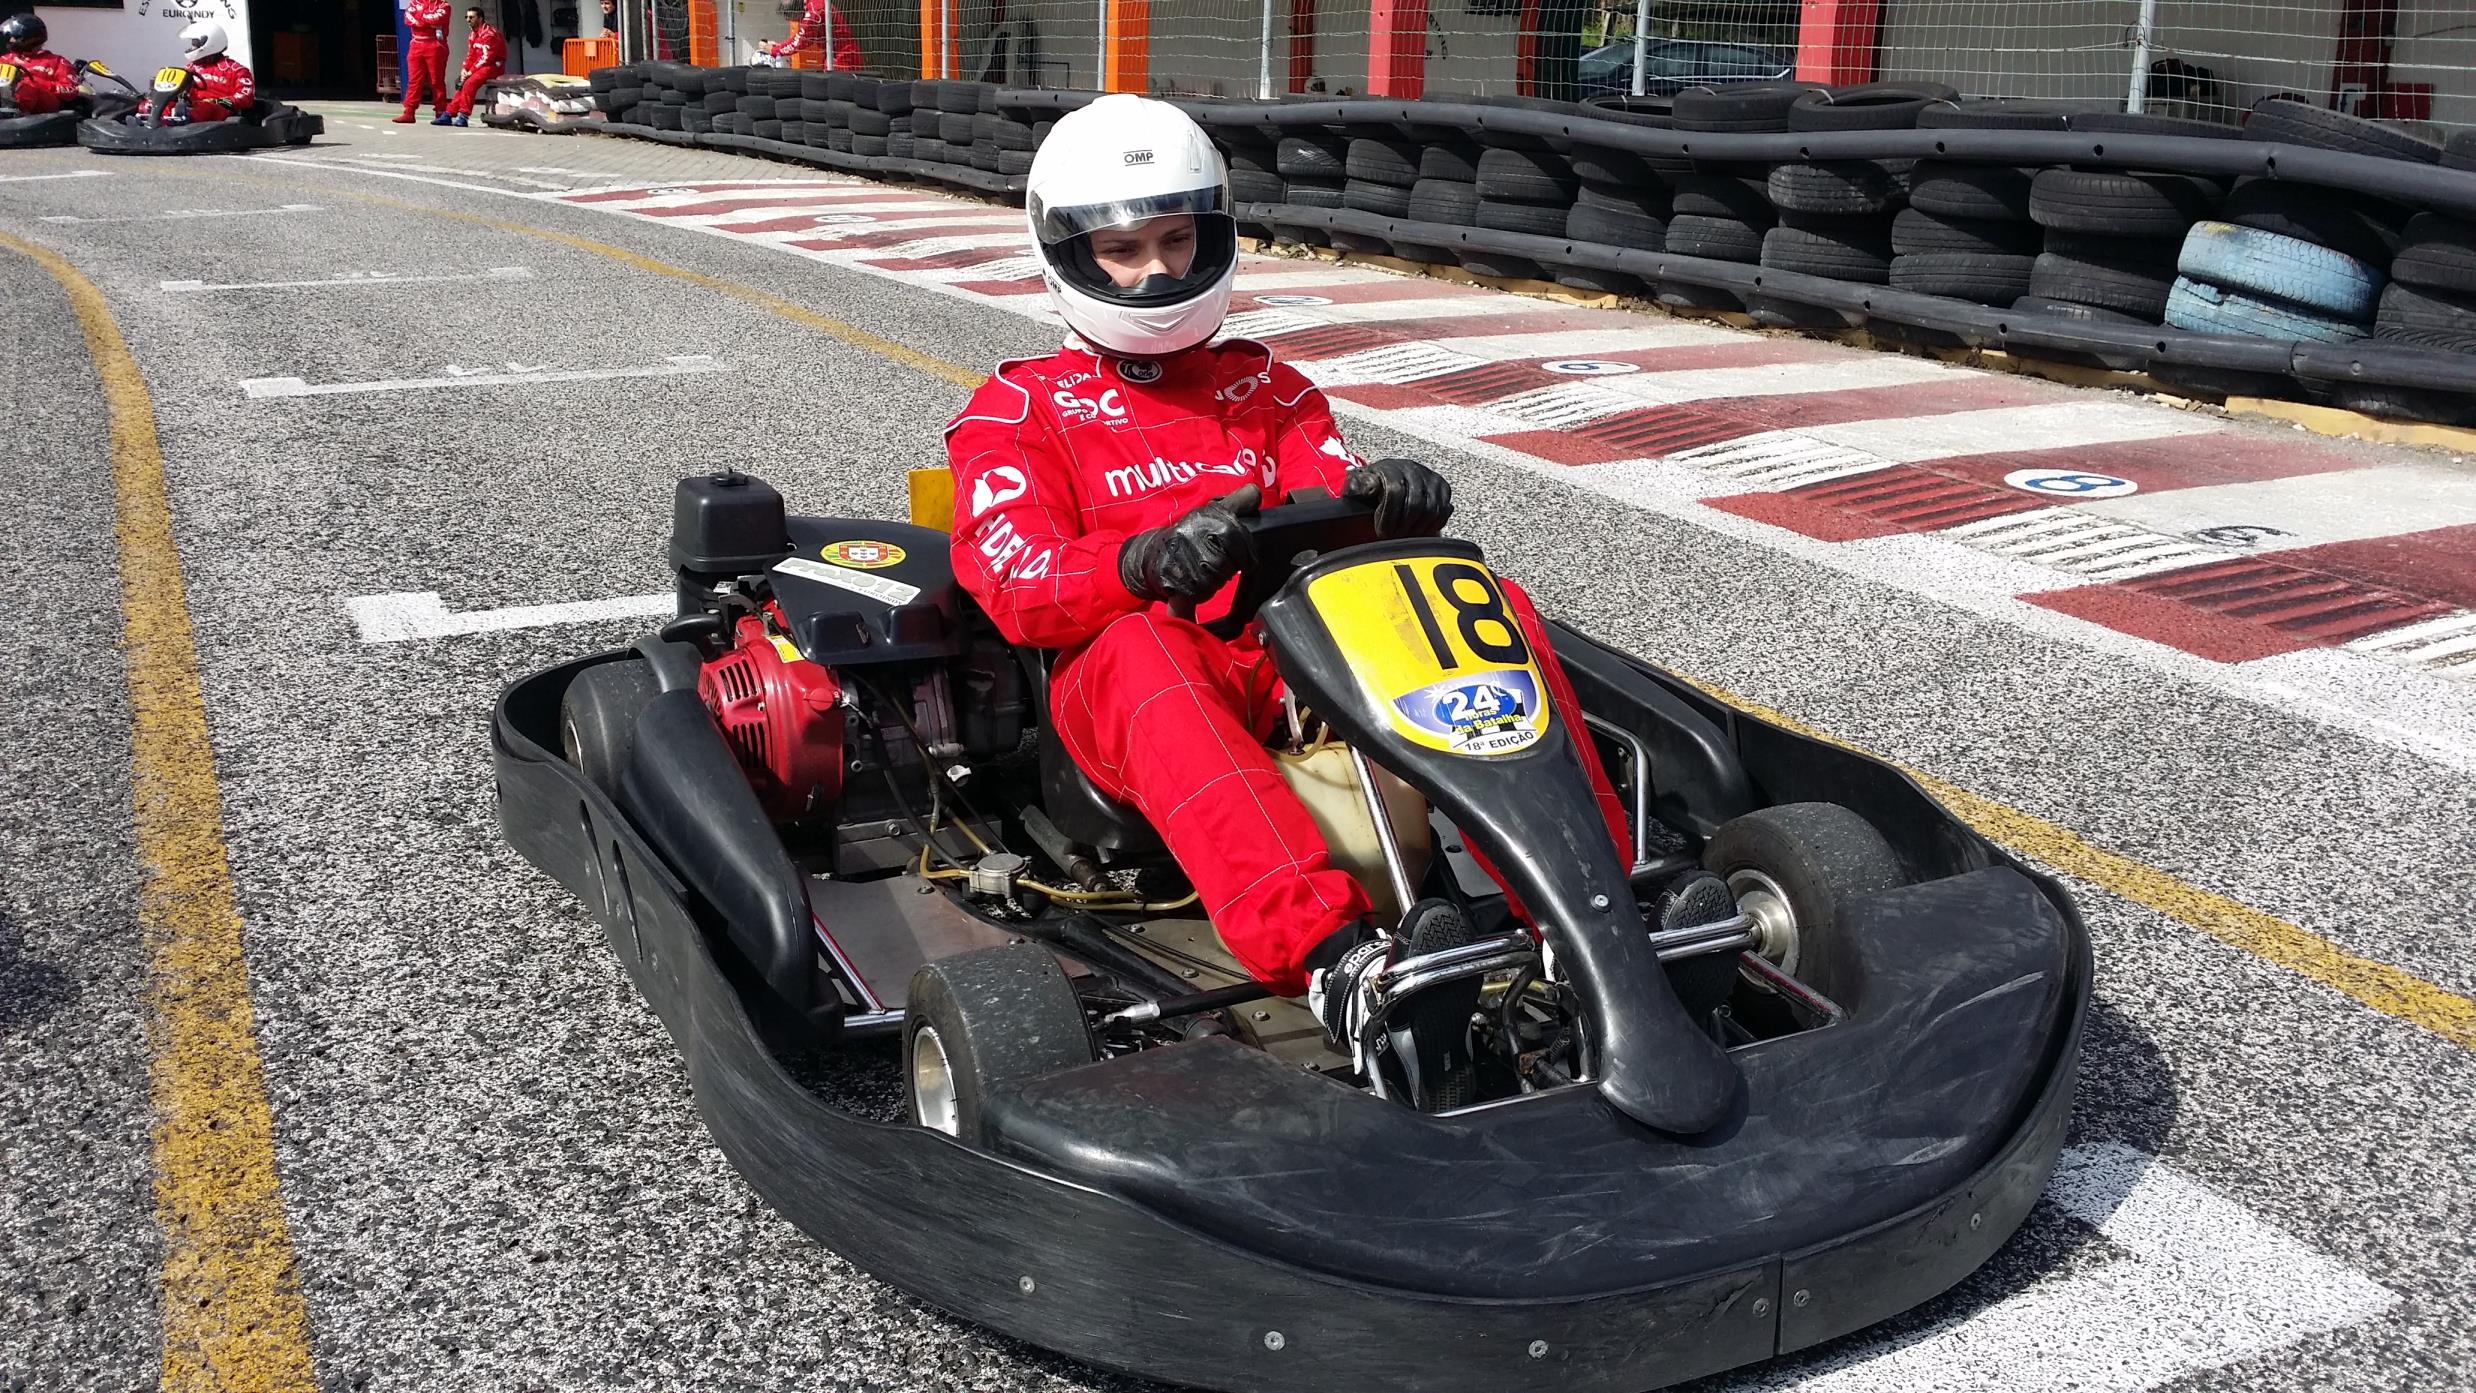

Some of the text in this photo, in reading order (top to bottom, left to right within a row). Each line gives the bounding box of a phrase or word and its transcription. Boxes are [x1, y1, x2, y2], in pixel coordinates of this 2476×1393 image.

[160, 69, 177, 82] 10
[1123, 151, 1154, 164] OMP
[1393, 563, 1530, 671] 18
[1442, 685, 1501, 721] 24
[1454, 713, 1522, 736] da Batalha
[1488, 731, 1535, 749] EDIÇÃO
